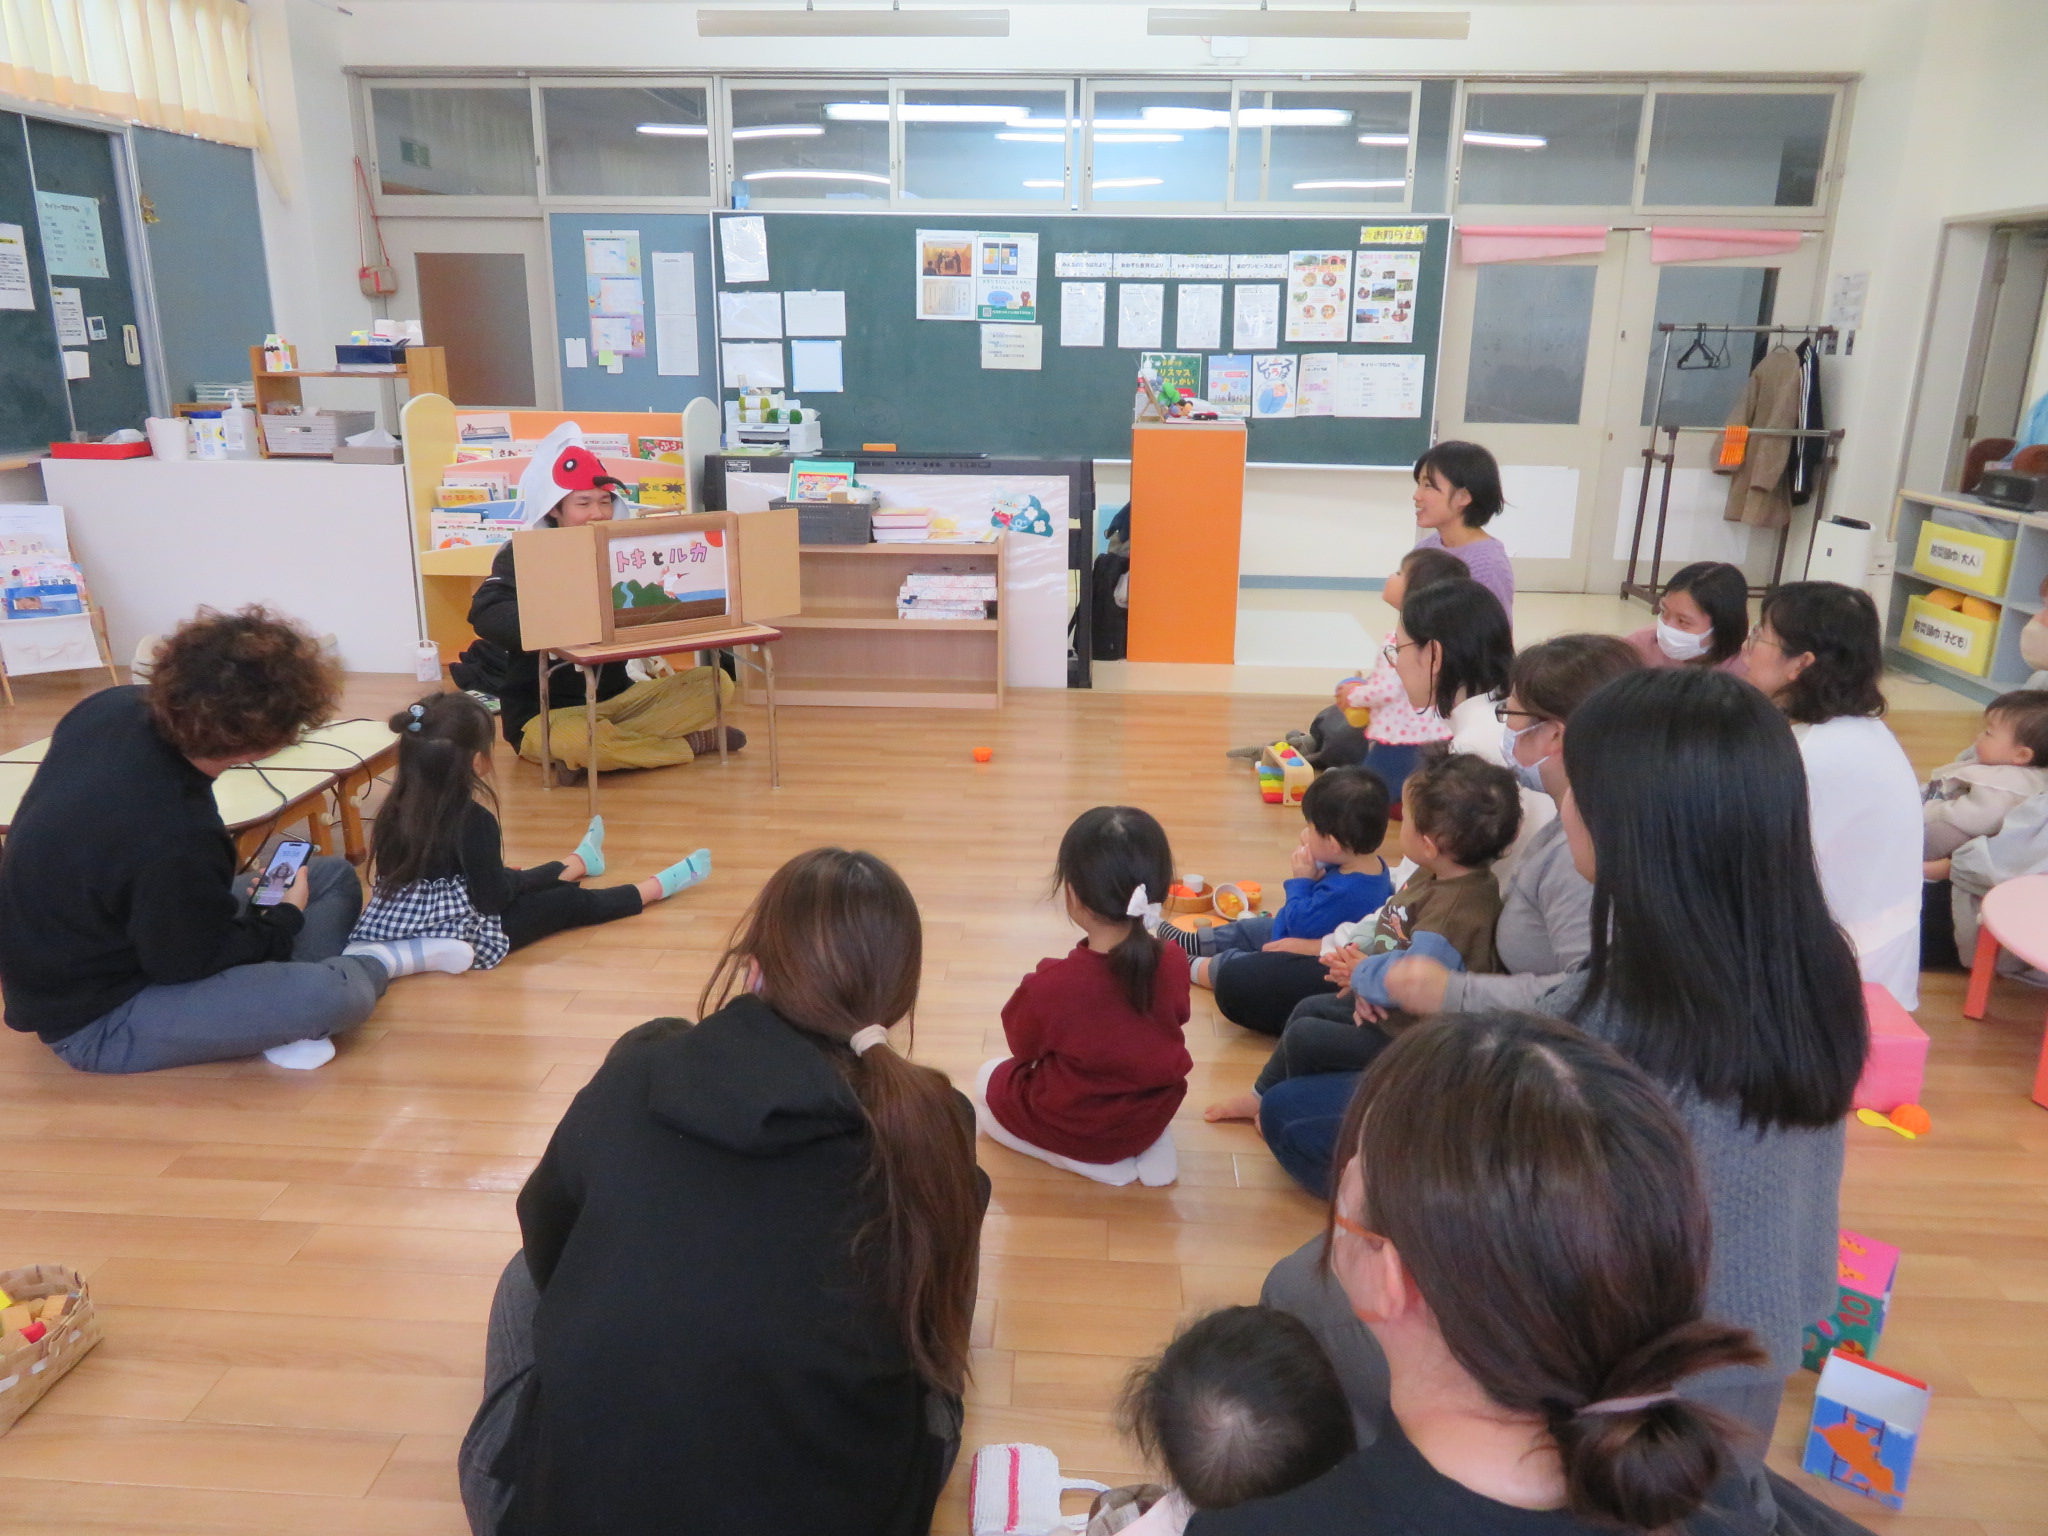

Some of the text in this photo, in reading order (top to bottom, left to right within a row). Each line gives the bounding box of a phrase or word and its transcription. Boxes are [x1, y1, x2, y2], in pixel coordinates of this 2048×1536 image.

[1372, 229, 1414, 240] お知らせ
[1256, 358, 1294, 373] ピース
[616, 542, 708, 573] トキとルカ
[1837, 1295, 1872, 1327] 10
